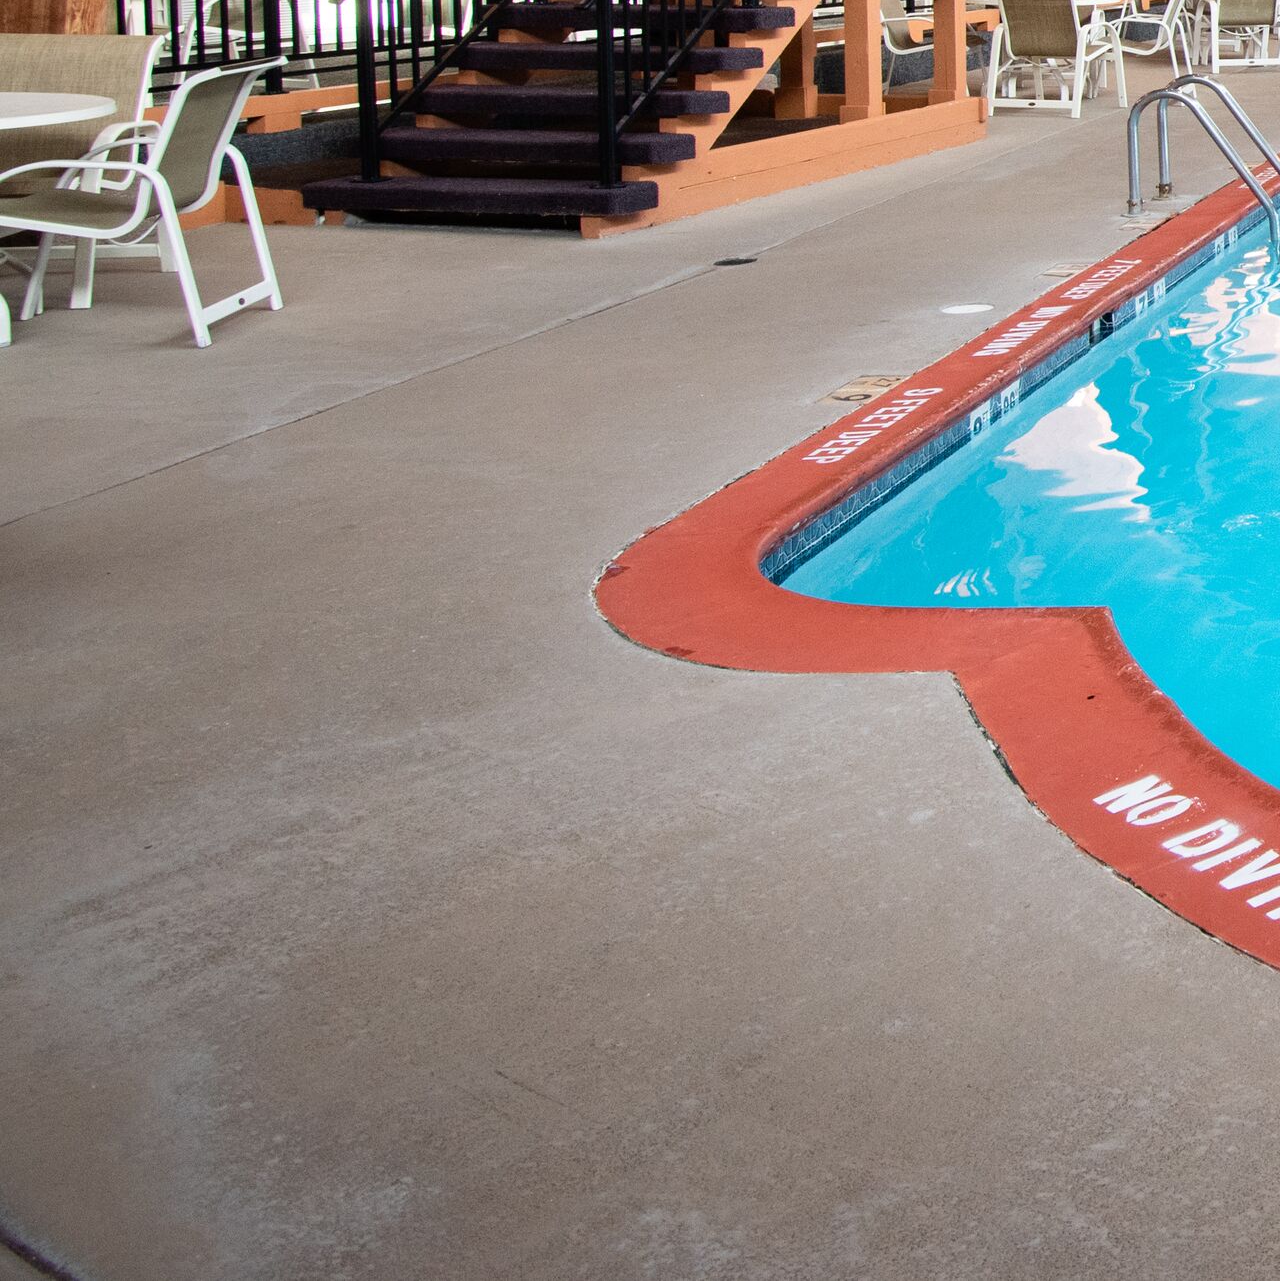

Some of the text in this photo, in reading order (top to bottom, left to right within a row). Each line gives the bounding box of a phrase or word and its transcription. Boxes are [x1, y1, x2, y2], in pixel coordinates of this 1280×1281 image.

[1060, 281, 1110, 300] DEEP
[1087, 265, 1135, 282] FEET
[972, 305, 1073, 357] NO DIVING
[802, 387, 944, 464] 9 FEET DEEP
[1093, 774, 1193, 826] NO
